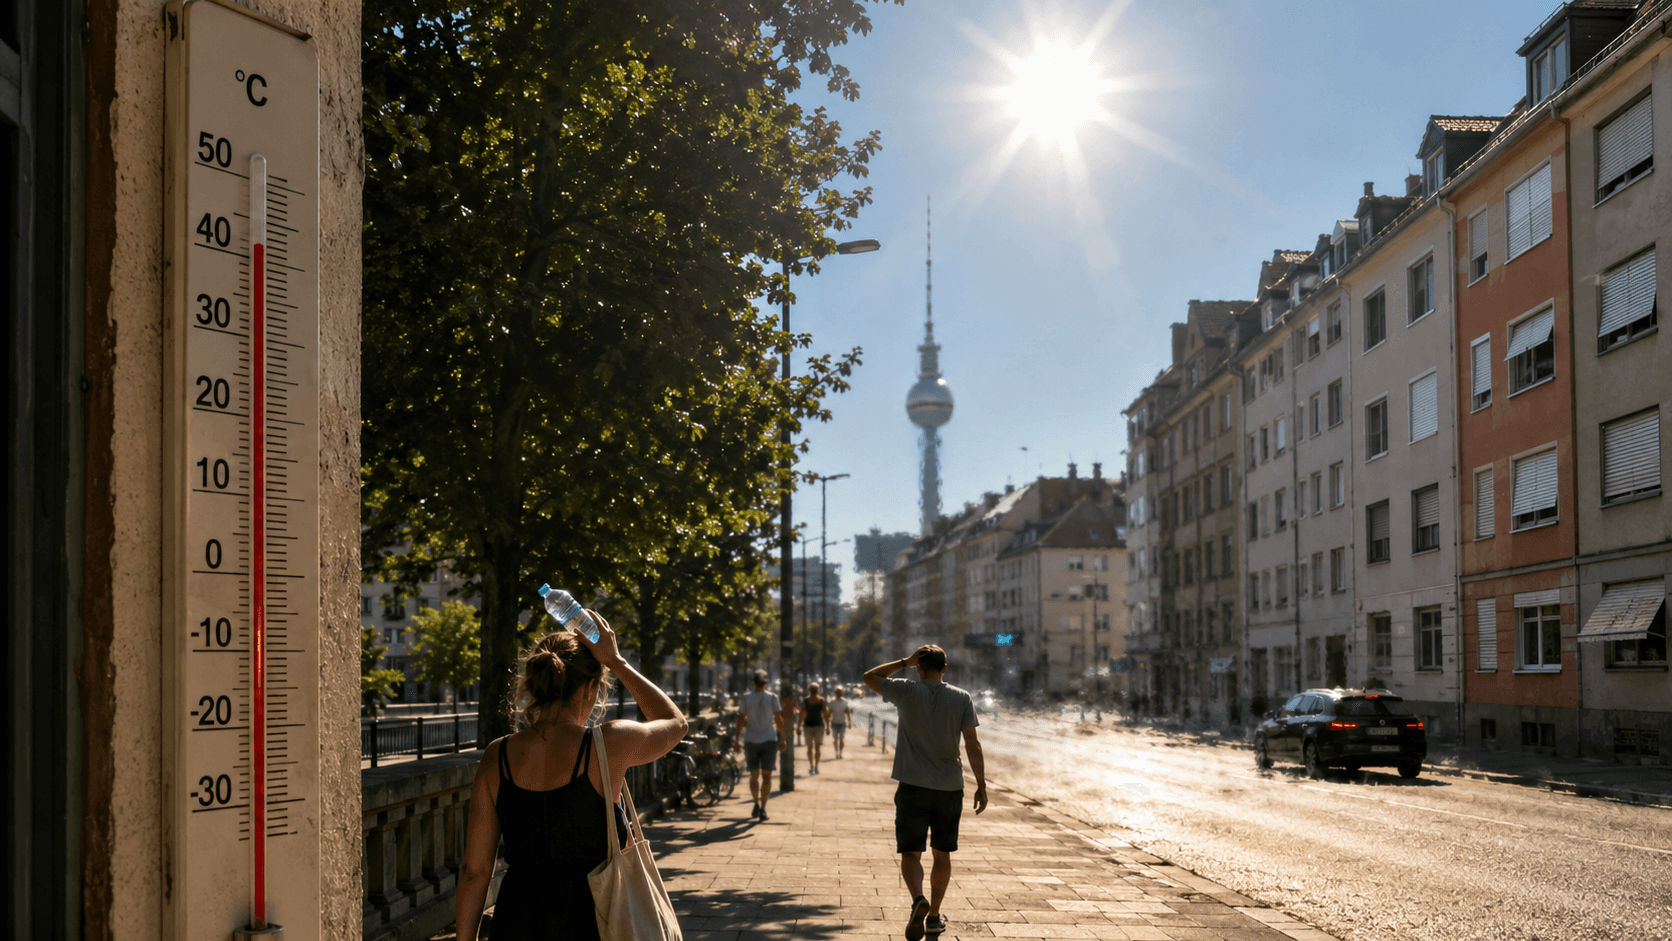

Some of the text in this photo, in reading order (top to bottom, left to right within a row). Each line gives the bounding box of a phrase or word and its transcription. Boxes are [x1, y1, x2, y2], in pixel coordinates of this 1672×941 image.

[234, 69, 268, 107] °C
[198, 130, 233, 169] 50
[196, 212, 231, 248] 40
[196, 293, 231, 329] 30
[196, 375, 230, 410] 20
[196, 456, 230, 490] 10
[205, 538, 223, 570] 0
[190, 616, 232, 648] -10
[190, 694, 232, 726] -20
[190, 773, 232, 807] -30
